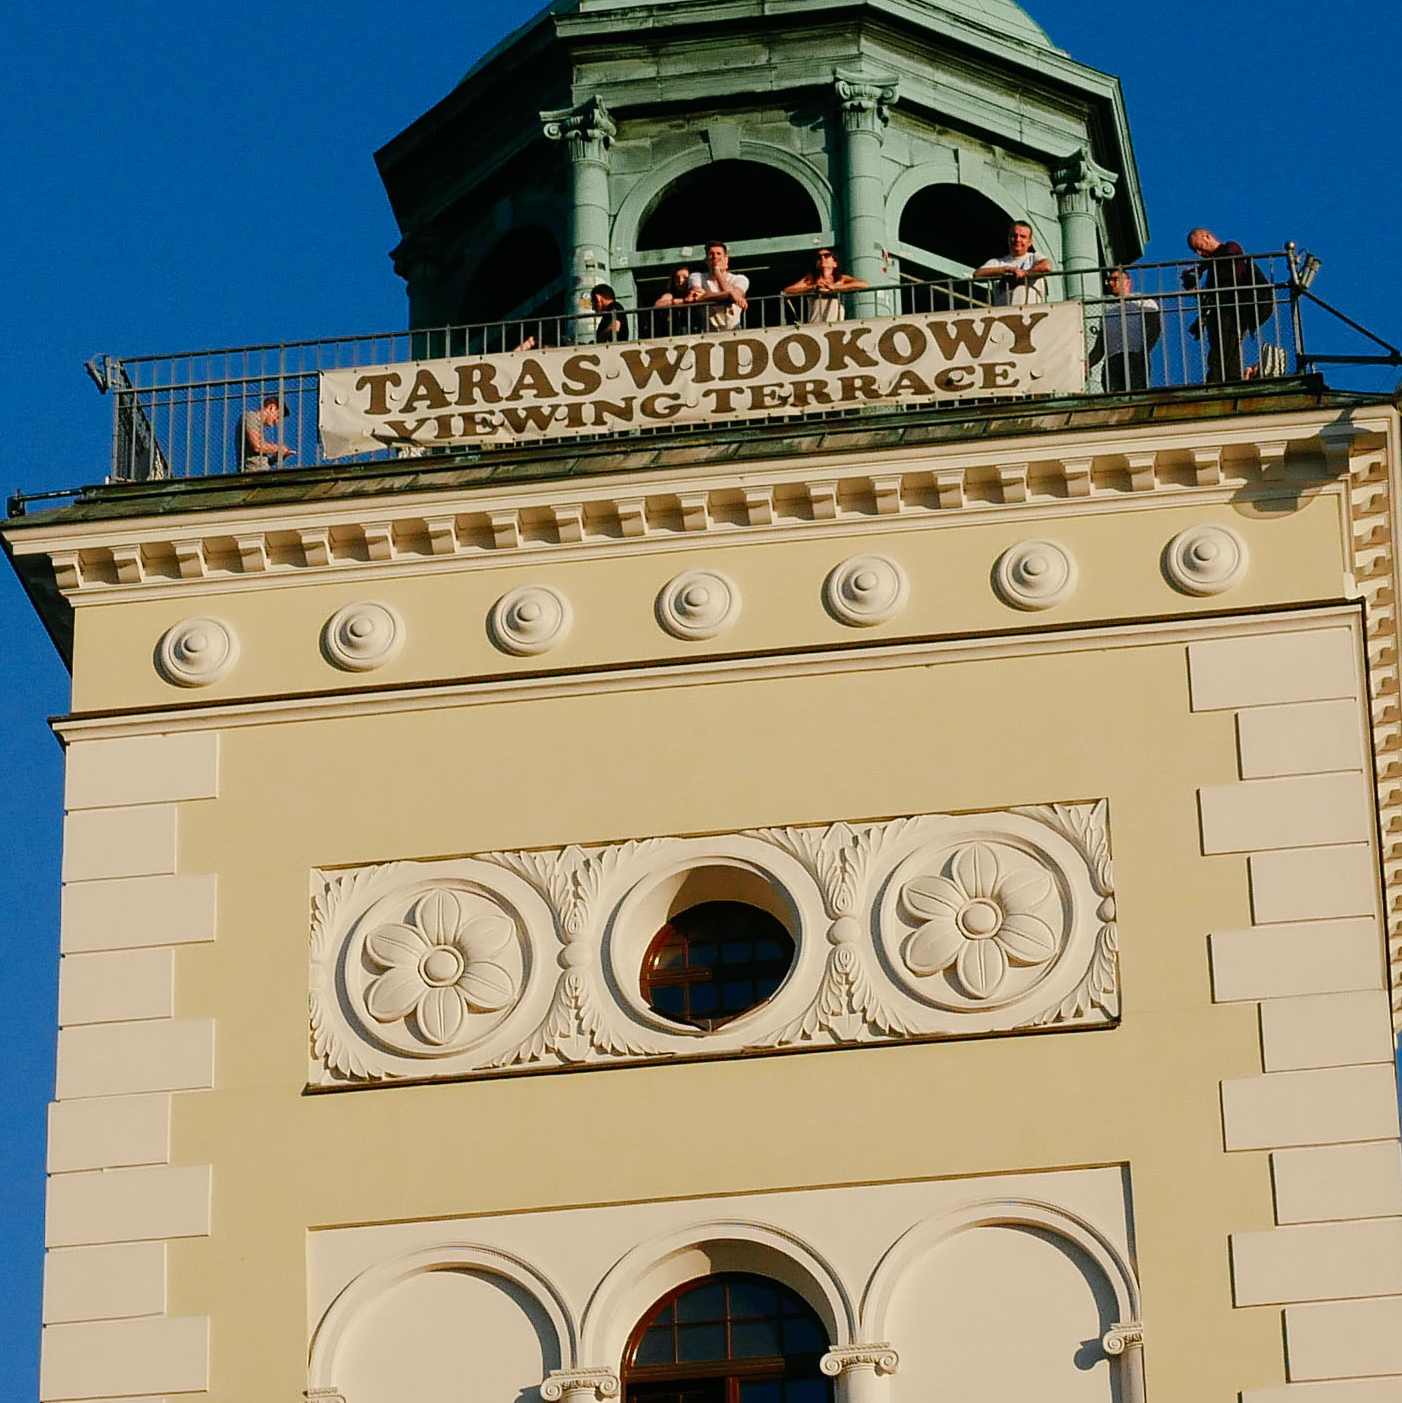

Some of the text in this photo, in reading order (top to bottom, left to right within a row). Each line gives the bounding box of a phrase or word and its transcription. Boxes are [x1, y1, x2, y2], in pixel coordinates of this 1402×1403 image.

[356, 312, 1049, 415] TARAS WIDOKOWY
[383, 361, 1020, 440] VIEWING TERRACE
